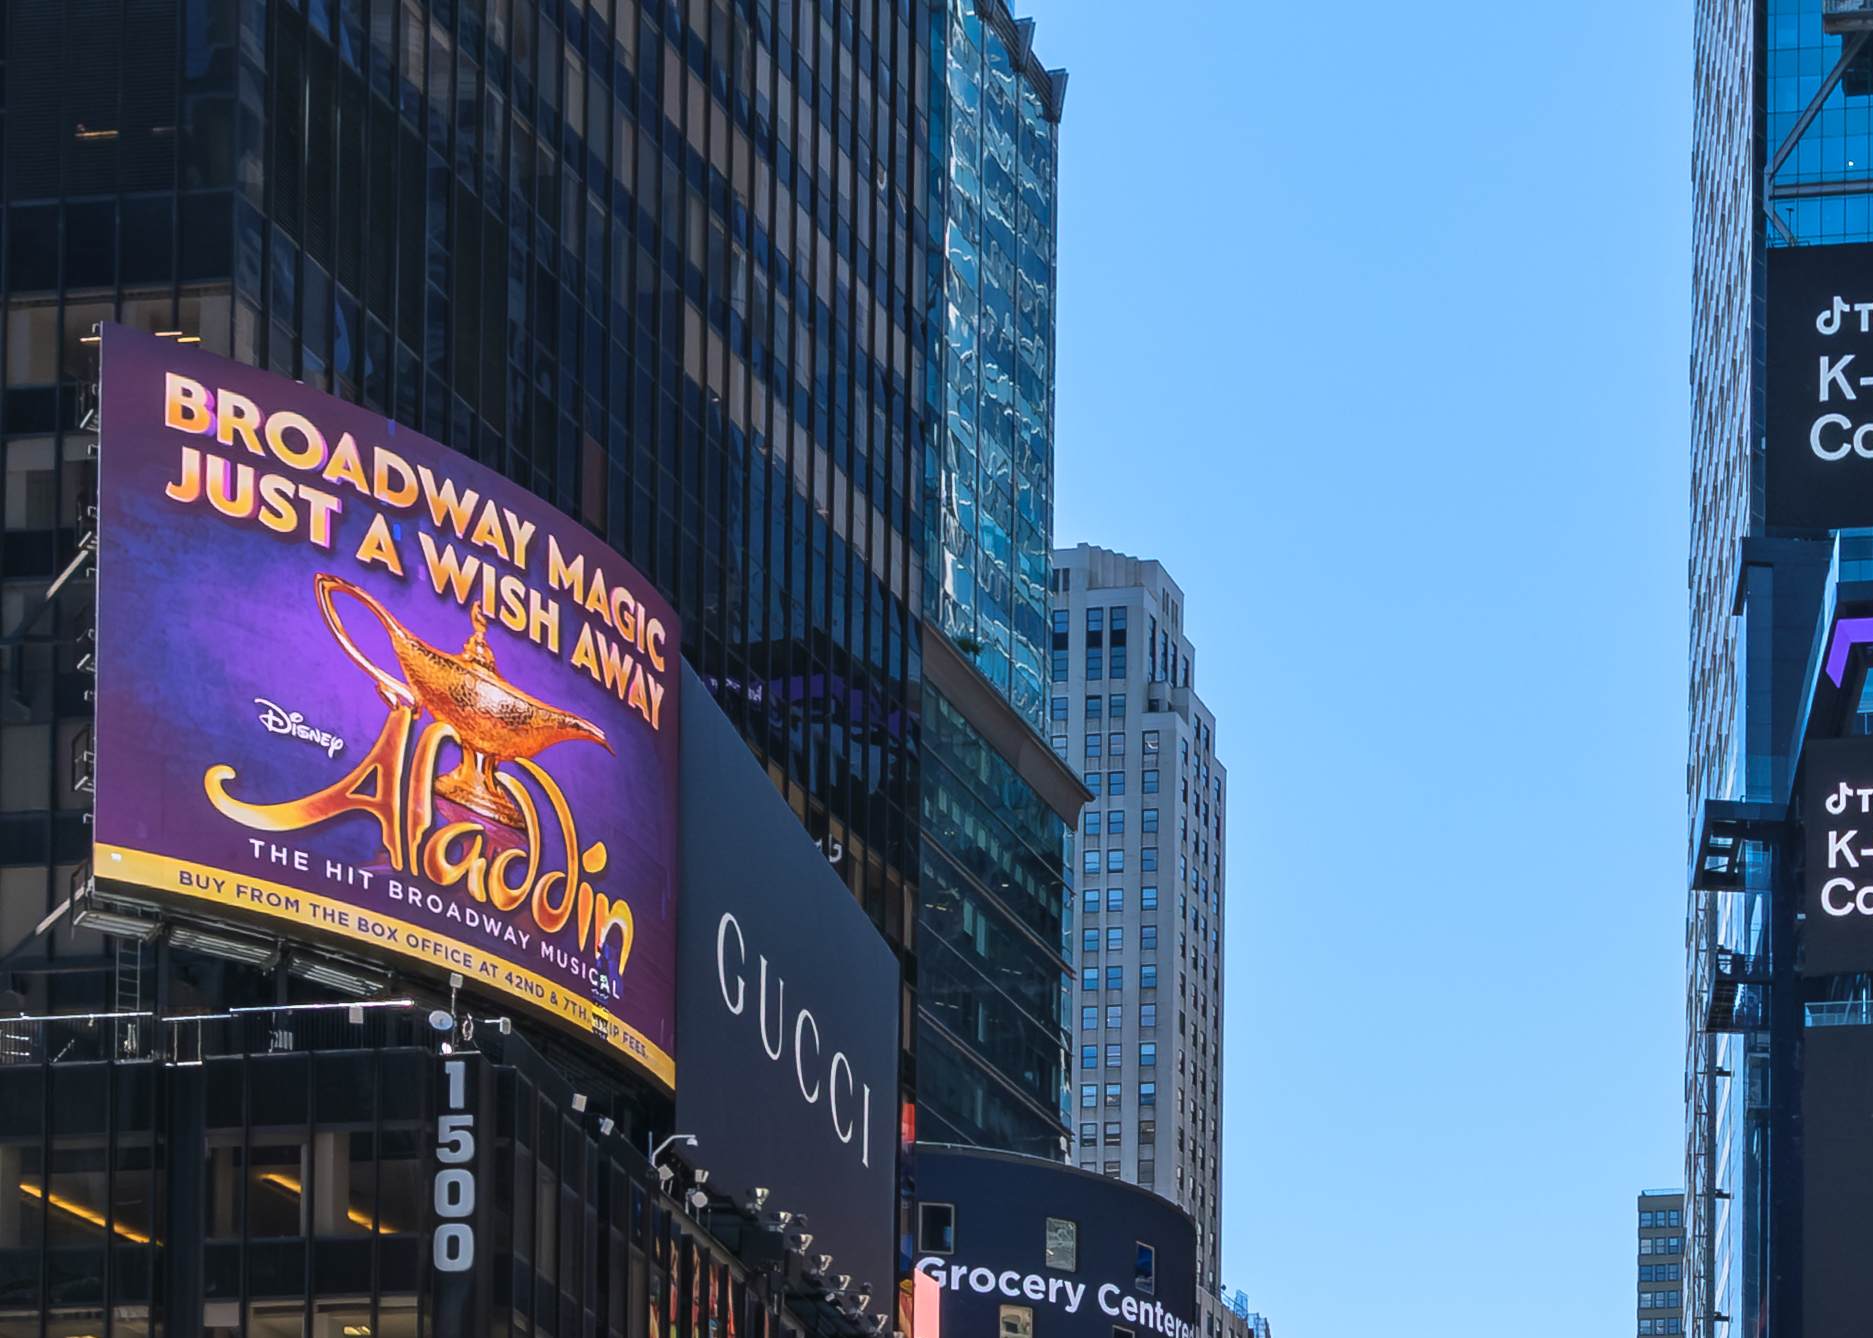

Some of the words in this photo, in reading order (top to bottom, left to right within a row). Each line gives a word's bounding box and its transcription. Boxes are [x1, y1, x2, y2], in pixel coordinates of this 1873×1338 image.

[164, 372, 536, 566] BROADWAY
[547, 536, 667, 668] MAGIC
[166, 446, 342, 549] JUST
[356, 513, 403, 577] A
[418, 530, 560, 653] WISH
[571, 622, 666, 732] AWAY
[178, 869, 226, 894] BUY
[236, 884, 301, 913] FROM
[309, 902, 350, 928] THE
[357, 915, 399, 943] BOX
[405, 933, 474, 969] OFFICE
[478, 957, 499, 979] AT
[504, 970, 546, 1000] 42ND
[549, 989, 560, 1008] &
[204, 704, 635, 976] Aladdin
[251, 839, 310, 871] THE
[325, 859, 374, 891] HIT
[388, 879, 531, 951] BROADWAY
[540, 941, 620, 1000] MUSICAL
[716, 911, 871, 1169] GUCCI
[433, 1060, 476, 1272] 1500
[914, 1256, 1086, 1314] Grocery
